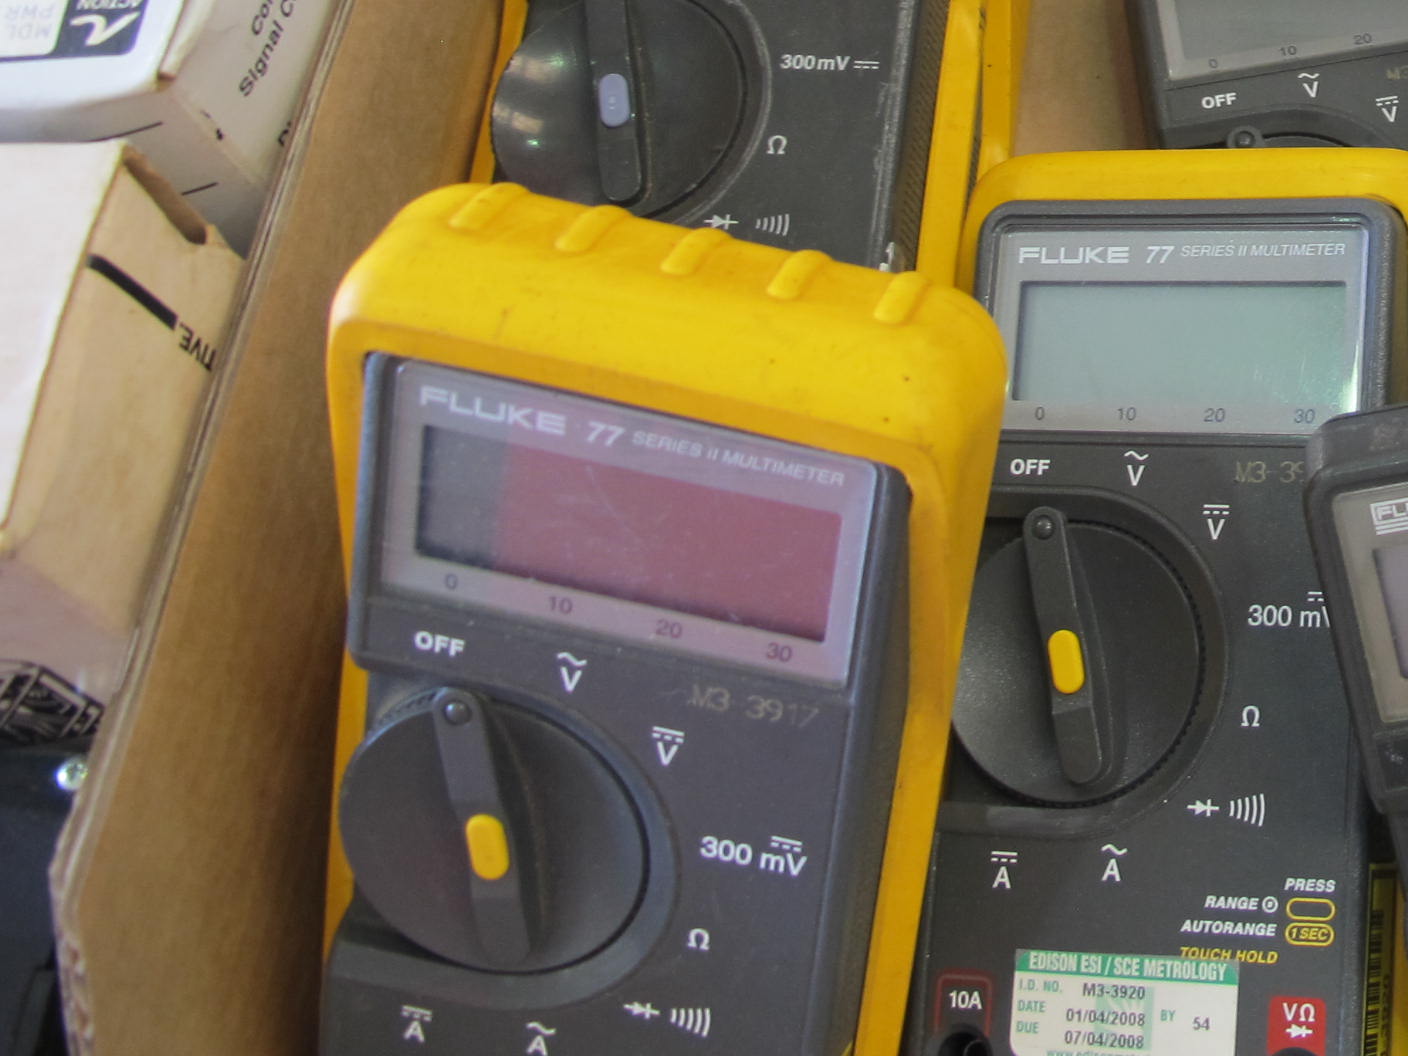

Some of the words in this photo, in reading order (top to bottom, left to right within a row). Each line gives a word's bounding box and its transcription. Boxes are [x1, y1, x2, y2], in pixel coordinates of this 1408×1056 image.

[1280, 44, 1297, 58] 10
[1353, 32, 1373, 47] 20
[239, 19, 284, 97] Signal
[1201, 92, 1236, 110] OFF
[1018, 246, 1129, 265] FLUKE
[1146, 246, 1173, 264] 77
[1180, 244, 1234, 258] SERIES
[1250, 242, 1345, 258] MULTIMETER
[1118, 407, 1136, 422] 10
[1204, 407, 1226, 423] 20
[1293, 408, 1316, 425] 30
[420, 385, 566, 436] FLUKE
[587, 420, 625, 448] 77
[633, 429, 702, 457] SERIES
[721, 448, 845, 487] MULTIMETER
[1010, 458, 1051, 476] OFF
[1247, 604, 1292, 628] 300
[547, 594, 573, 616] 10
[656, 618, 683, 640] 20
[765, 642, 792, 664] 30
[414, 630, 464, 657] OFF
[700, 834, 752, 867] 300
[759, 847, 807, 877] mV
[1284, 878, 1336, 893] PRESS
[1205, 896, 1259, 911] RANGE
[1180, 920, 1278, 937] AUTORANGE
[1029, 950, 1077, 973] EDISON
[1080, 954, 1101, 974] ESI
[1113, 956, 1140, 976] SCE
[1144, 958, 1227, 981] METROLOGY
[1179, 947, 1233, 963] TOUCH
[1236, 948, 1278, 965] HOLD
[948, 991, 983, 1010] 10A
[1018, 978, 1039, 991] I.D.
[1043, 980, 1062, 993] NO.
[1082, 982, 1146, 1000] M3-3920
[1017, 999, 1045, 1013] DATE
[1065, 1008, 1146, 1027] 01/04/2008
[1160, 1009, 1176, 1022] BY
[1192, 1016, 1210, 1031] 54
[1016, 1020, 1039, 1034] DUE
[1064, 1030, 1145, 1049] 07/04/2008
